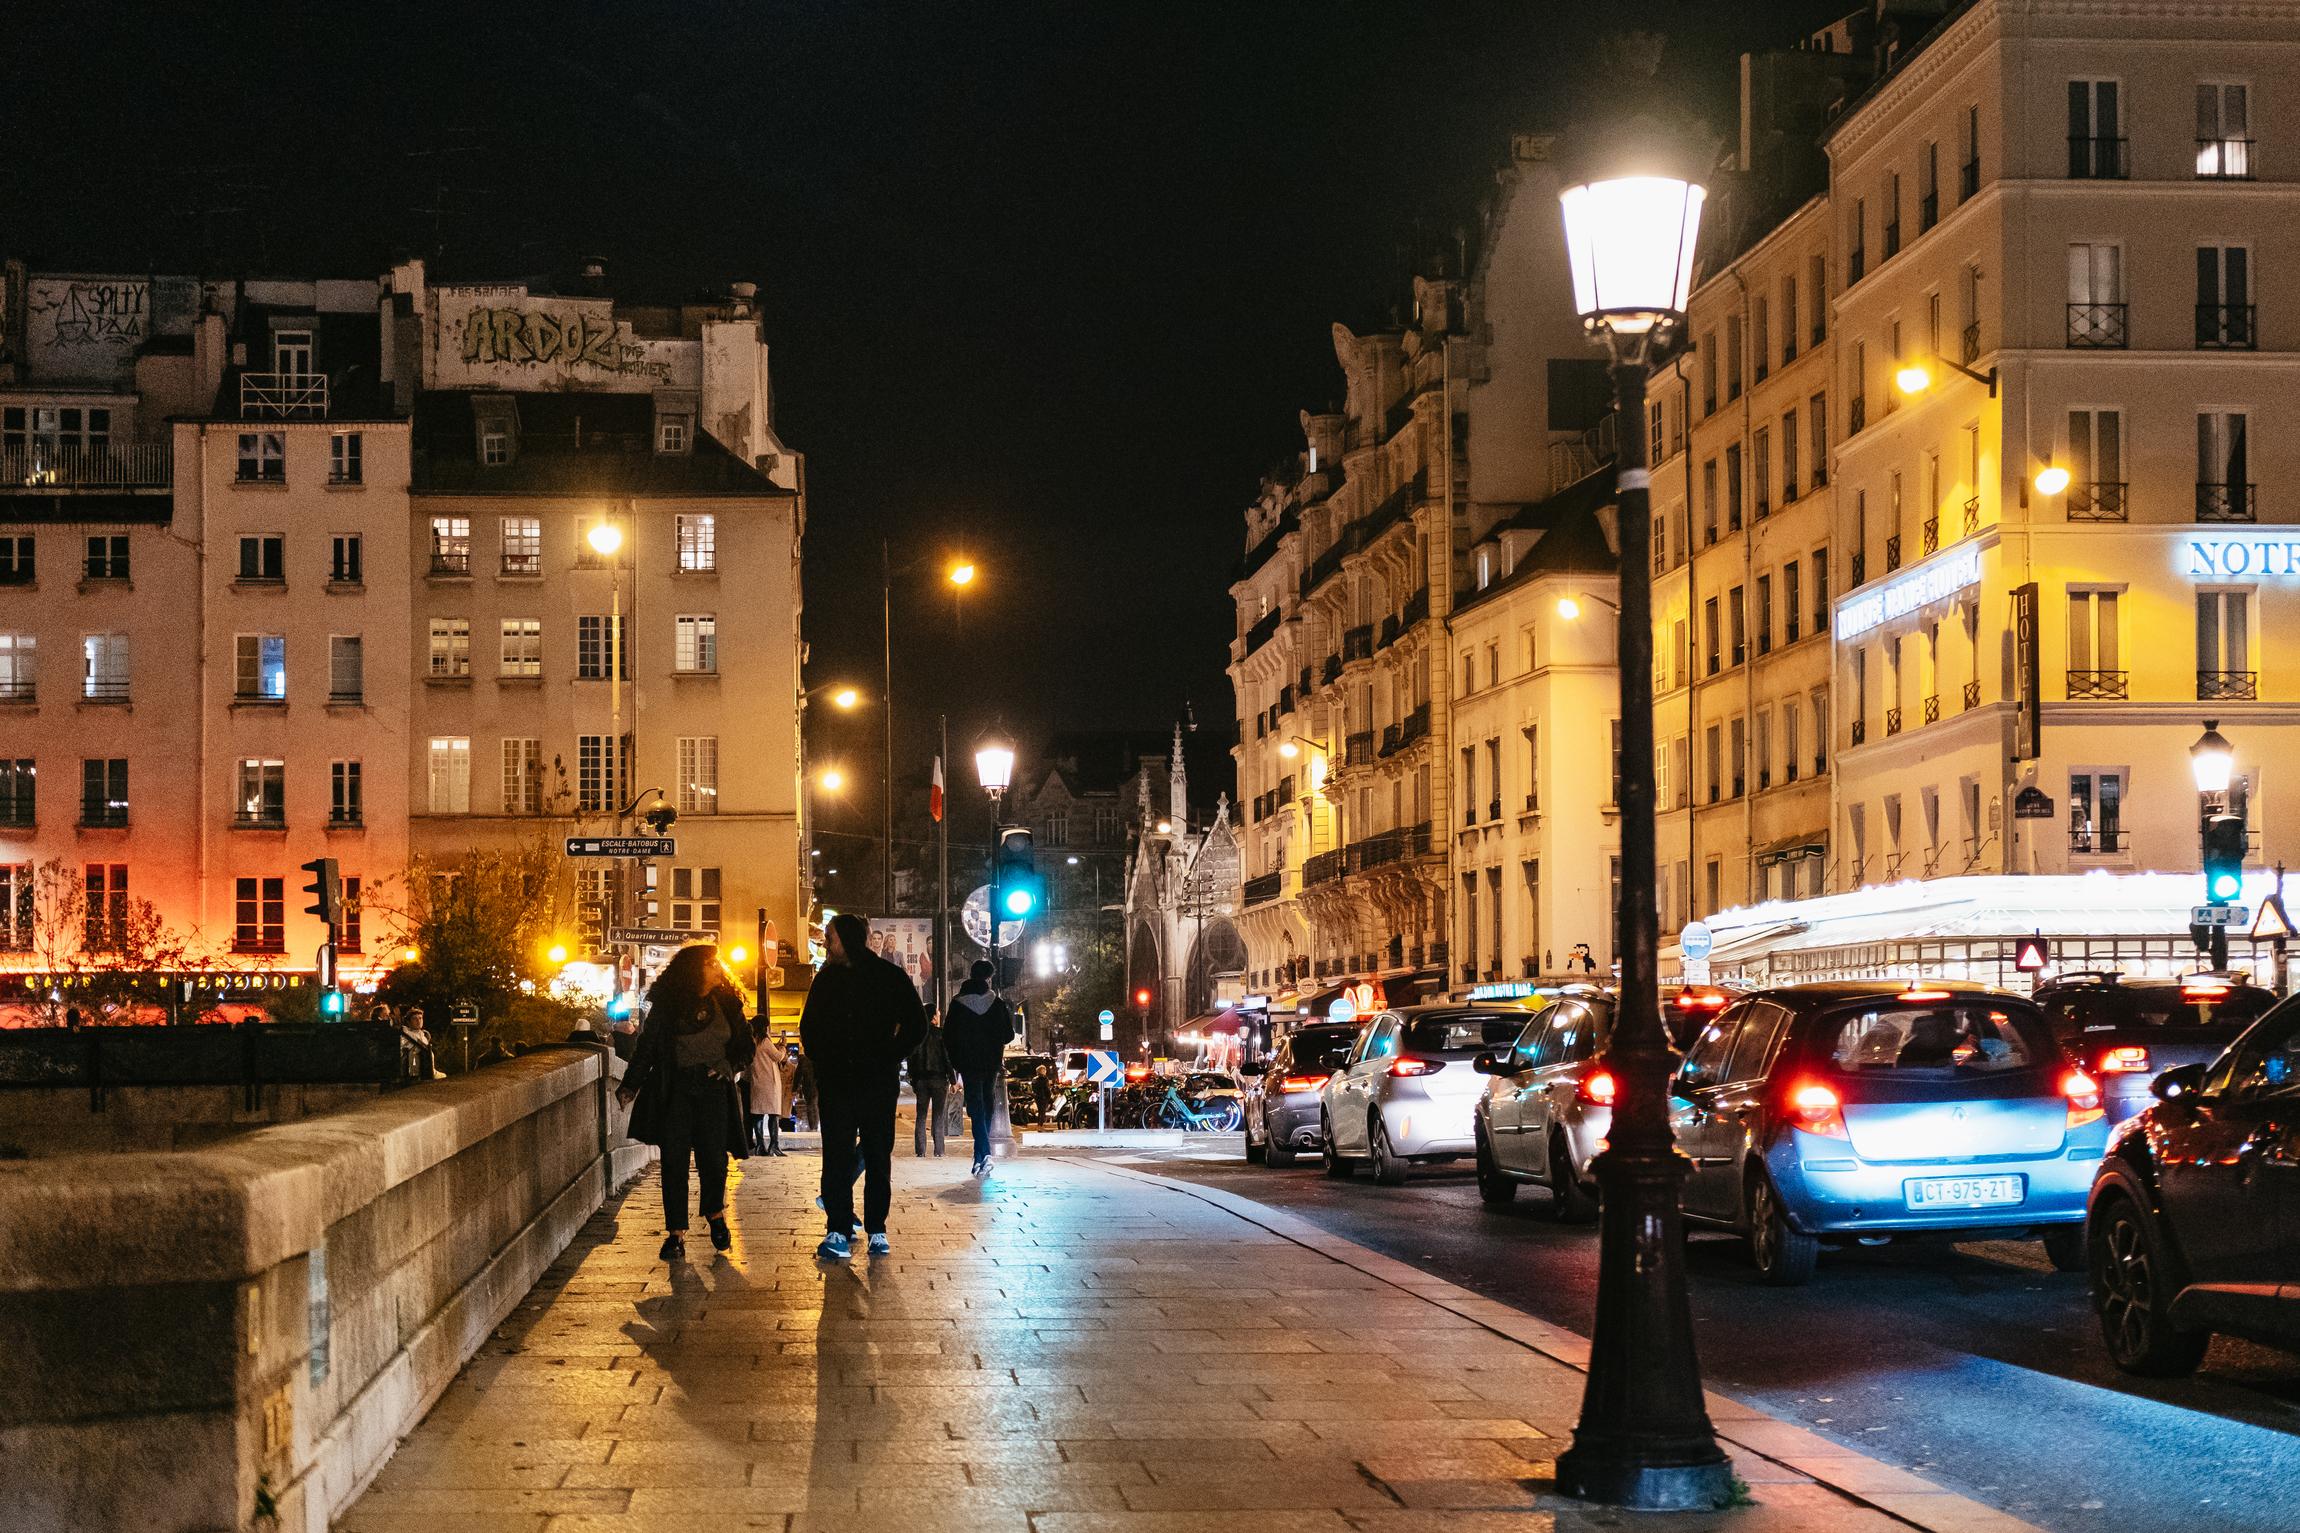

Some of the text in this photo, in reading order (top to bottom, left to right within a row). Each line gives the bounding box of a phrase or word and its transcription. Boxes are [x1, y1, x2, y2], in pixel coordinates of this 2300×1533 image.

[463, 307, 622, 371] ARDOZ
[2019, 593, 2030, 713] HOTEL
[625, 932, 656, 940] Quartier
[1926, 1180, 2007, 1200] CT-975-ZT
